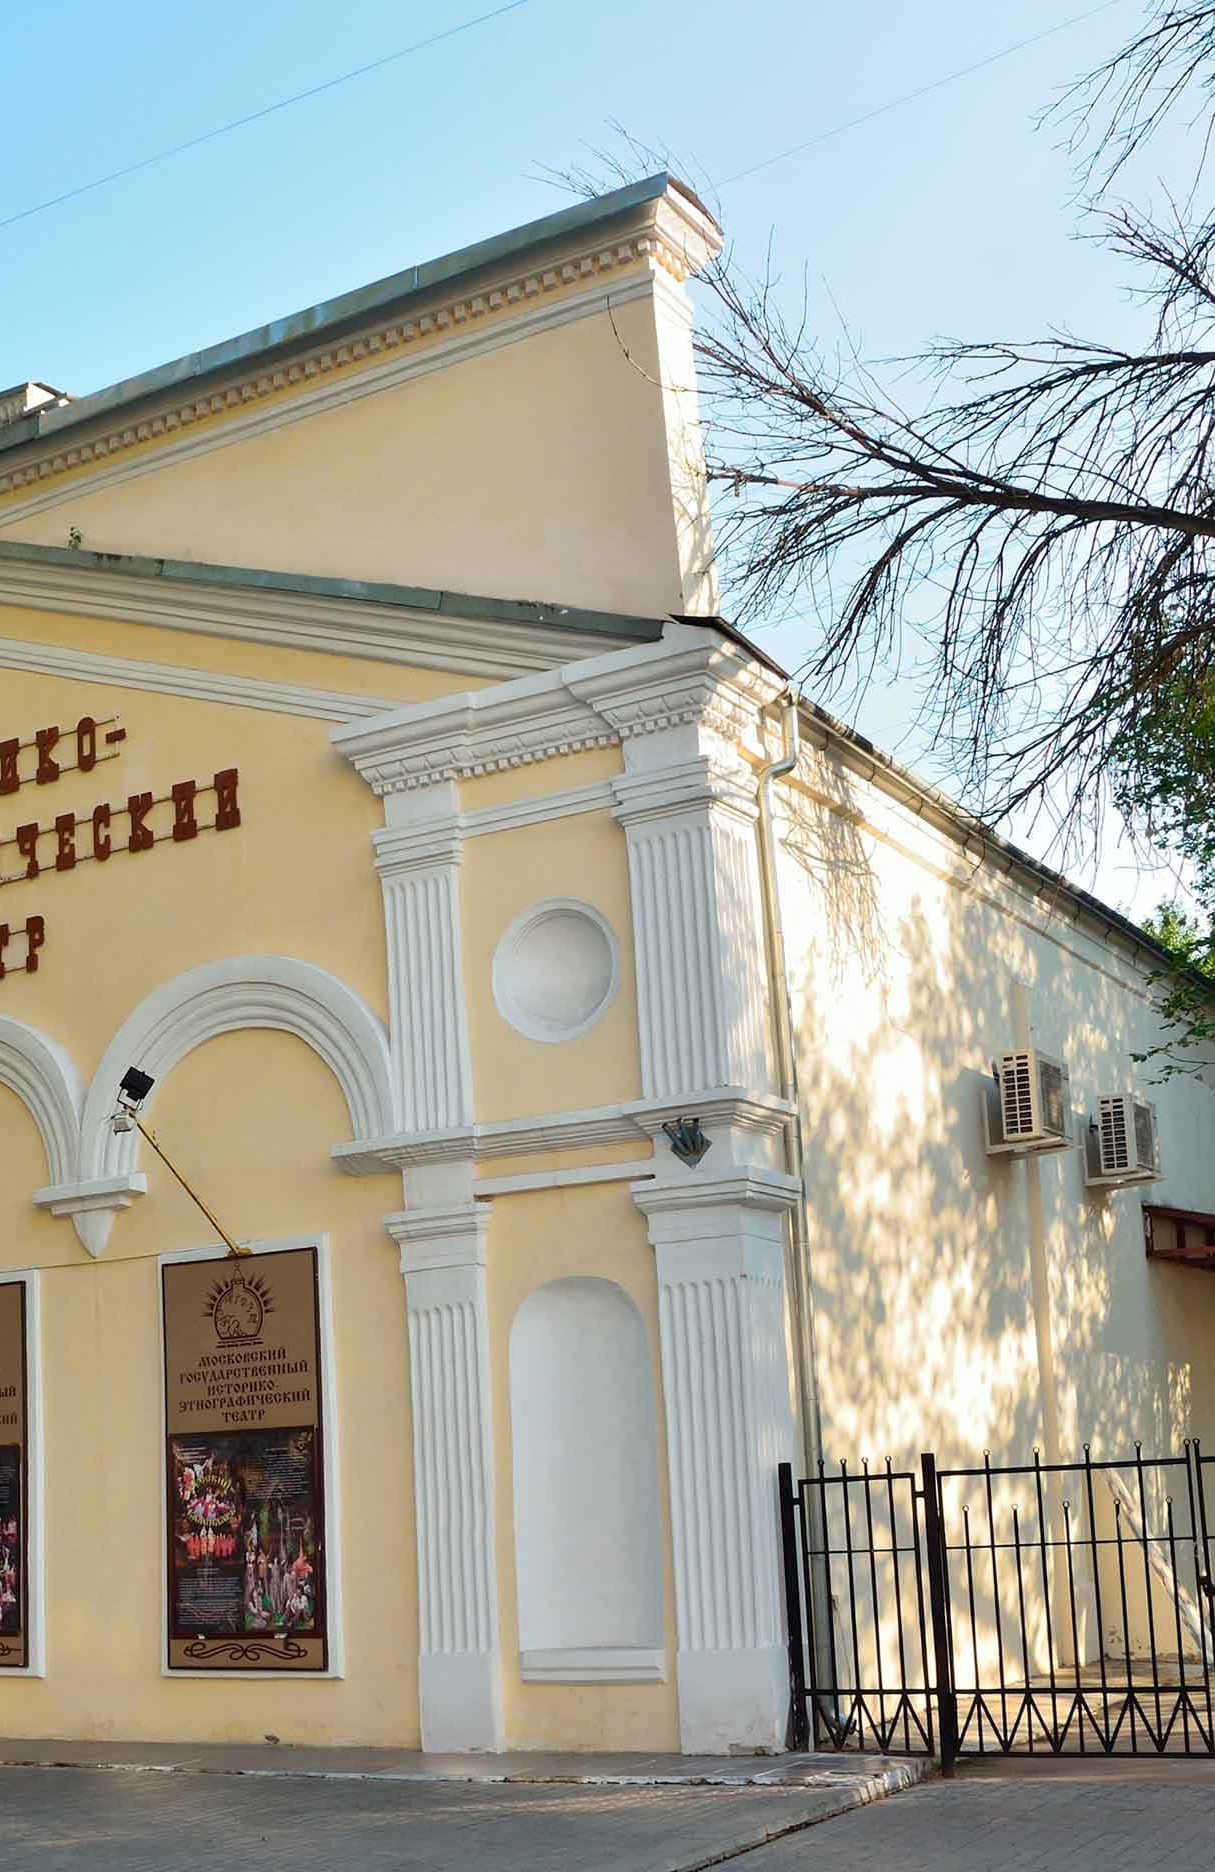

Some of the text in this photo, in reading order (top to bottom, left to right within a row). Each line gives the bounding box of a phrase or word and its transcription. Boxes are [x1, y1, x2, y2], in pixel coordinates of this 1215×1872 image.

[198, 1347, 286, 1367] МОСКОВСКИЙ
[179, 1360, 308, 1384] ГОСУДАРСТВЕННЫЙ
[178, 1388, 311, 1413] ЭТНОГРАФИЧЕСКИЙ
[221, 1409, 266, 1423] ТЕАТР
